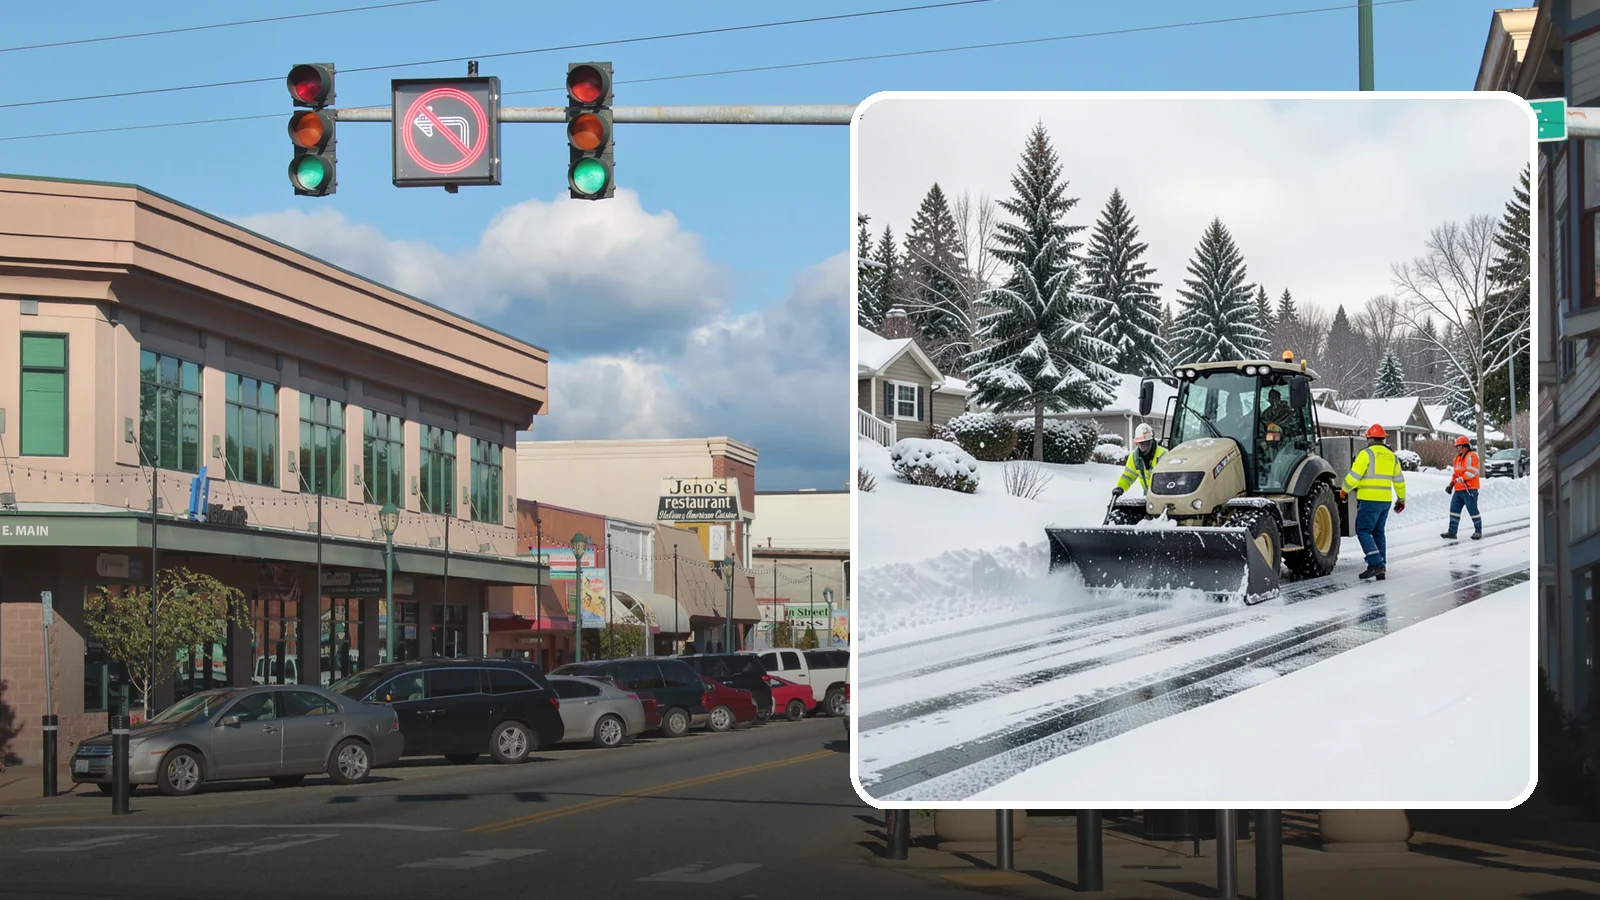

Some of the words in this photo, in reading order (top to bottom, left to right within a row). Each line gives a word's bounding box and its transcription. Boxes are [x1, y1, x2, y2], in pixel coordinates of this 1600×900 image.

[670, 480, 727, 494] Jeno's
[665, 496, 731, 509] restaurant
[659, 510, 682, 520] Italian
[686, 510, 715, 519] American
[715, 510, 737, 519] Cuisine
[2, 525, 13, 536] E.
[15, 525, 49, 536] MAIN
[797, 607, 828, 616] Street
[791, 619, 823, 627] lass
